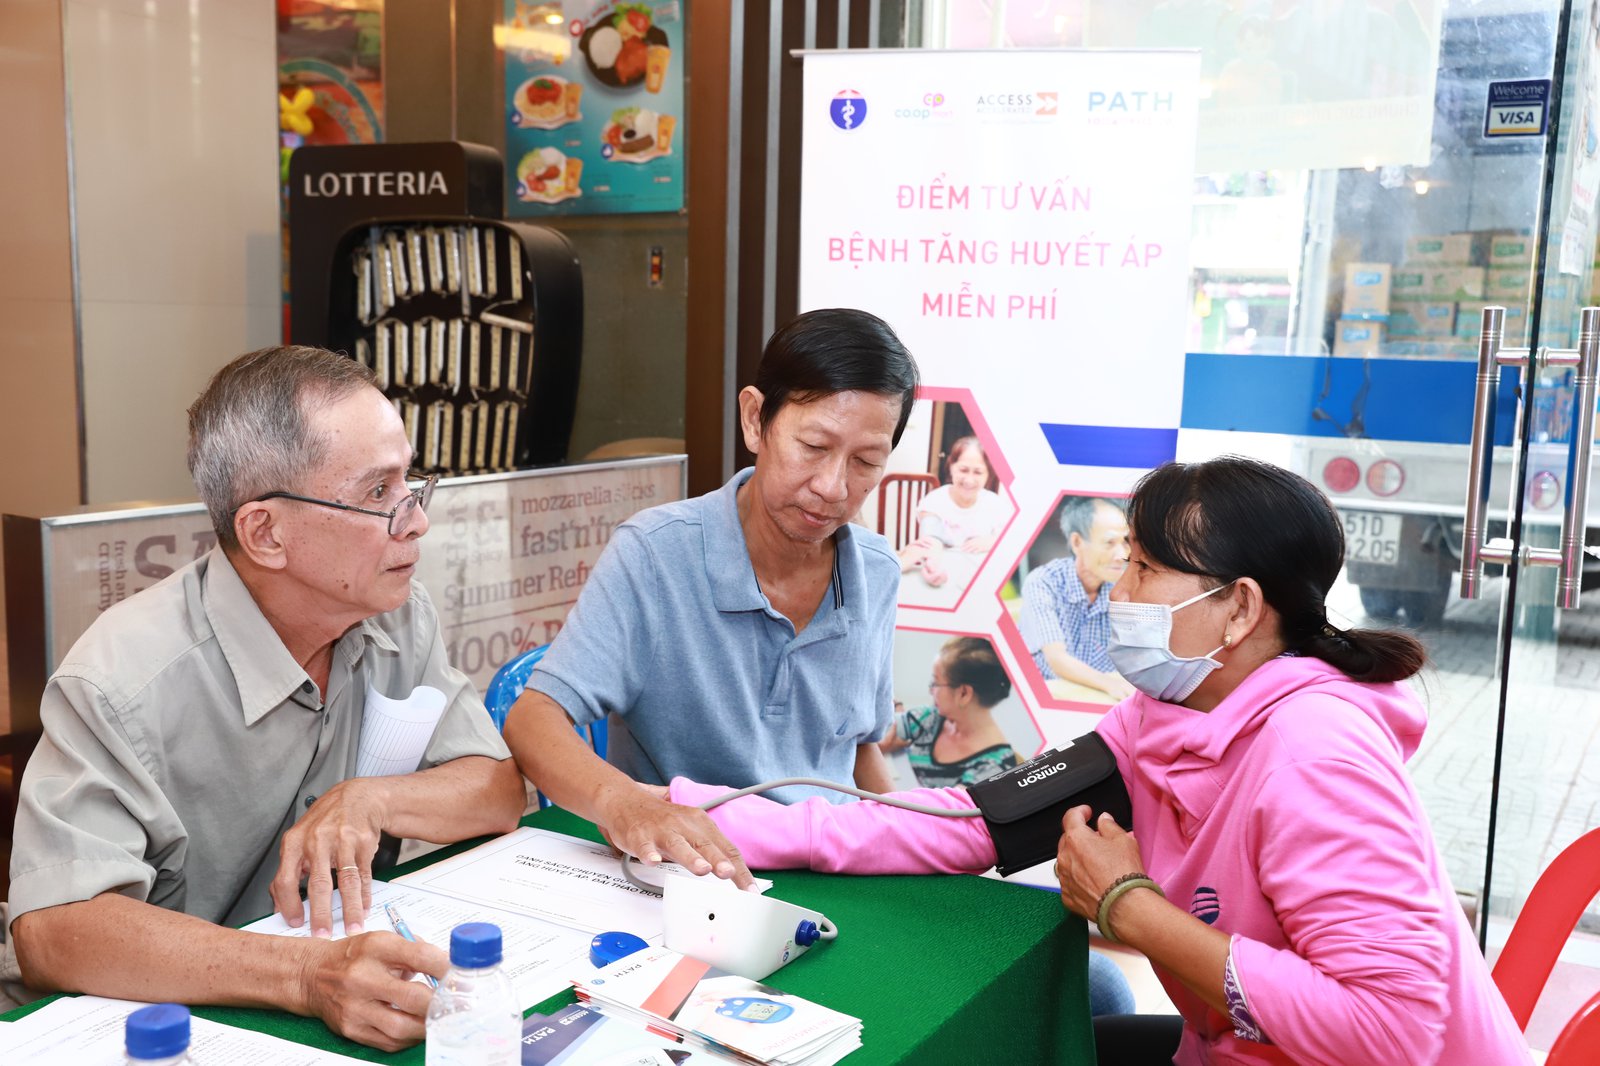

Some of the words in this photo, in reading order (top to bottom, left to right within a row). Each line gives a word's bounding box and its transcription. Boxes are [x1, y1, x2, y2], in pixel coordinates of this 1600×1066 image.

[976, 94, 1033, 106] ACCESS
[1088, 91, 1173, 112] PATH
[1493, 84, 1545, 96] Welcome
[1498, 111, 1535, 125] VISA
[303, 170, 449, 198] LOTTERIA
[897, 173, 970, 211] ĐIỂM
[981, 181, 1023, 211] TƯ
[1030, 175, 1092, 212] VẤN
[828, 231, 909, 270] BỆNH
[920, 232, 999, 265] TĂNG
[1010, 230, 1111, 268] HUYẾT
[1120, 234, 1163, 268] ÁP
[922, 282, 997, 319] MIỄN
[1008, 287, 1058, 321] PHÍ
[521, 486, 612, 515] mozzarella
[1345, 513, 1384, 537] 51D
[114, 540, 127, 579] fresh
[98, 541, 112, 612] crunchy
[444, 573, 549, 612] Summer
[446, 621, 539, 676] 100%
[516, 854, 545, 864] DANH
[613, 963, 643, 978] PATH
[523, 1026, 556, 1045] PATH
